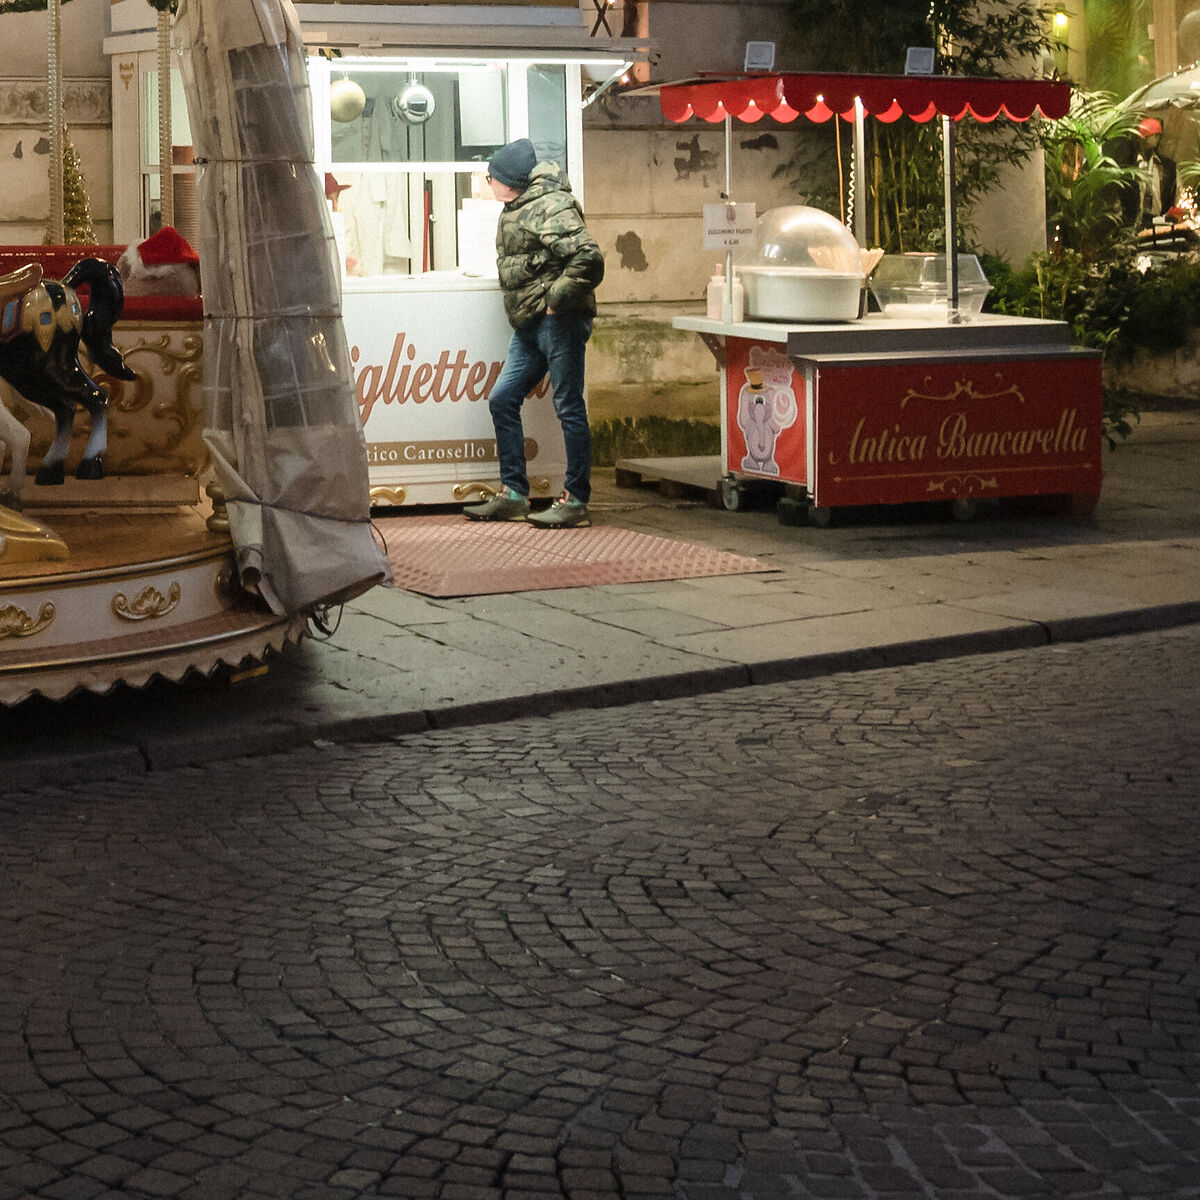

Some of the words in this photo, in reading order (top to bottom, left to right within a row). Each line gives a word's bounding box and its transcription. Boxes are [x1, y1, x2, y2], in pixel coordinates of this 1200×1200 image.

[366, 446, 398, 462] tico
[403, 443, 486, 461] Carosello
[829, 416, 927, 465] Antica
[936, 408, 1088, 459] Bancarella
